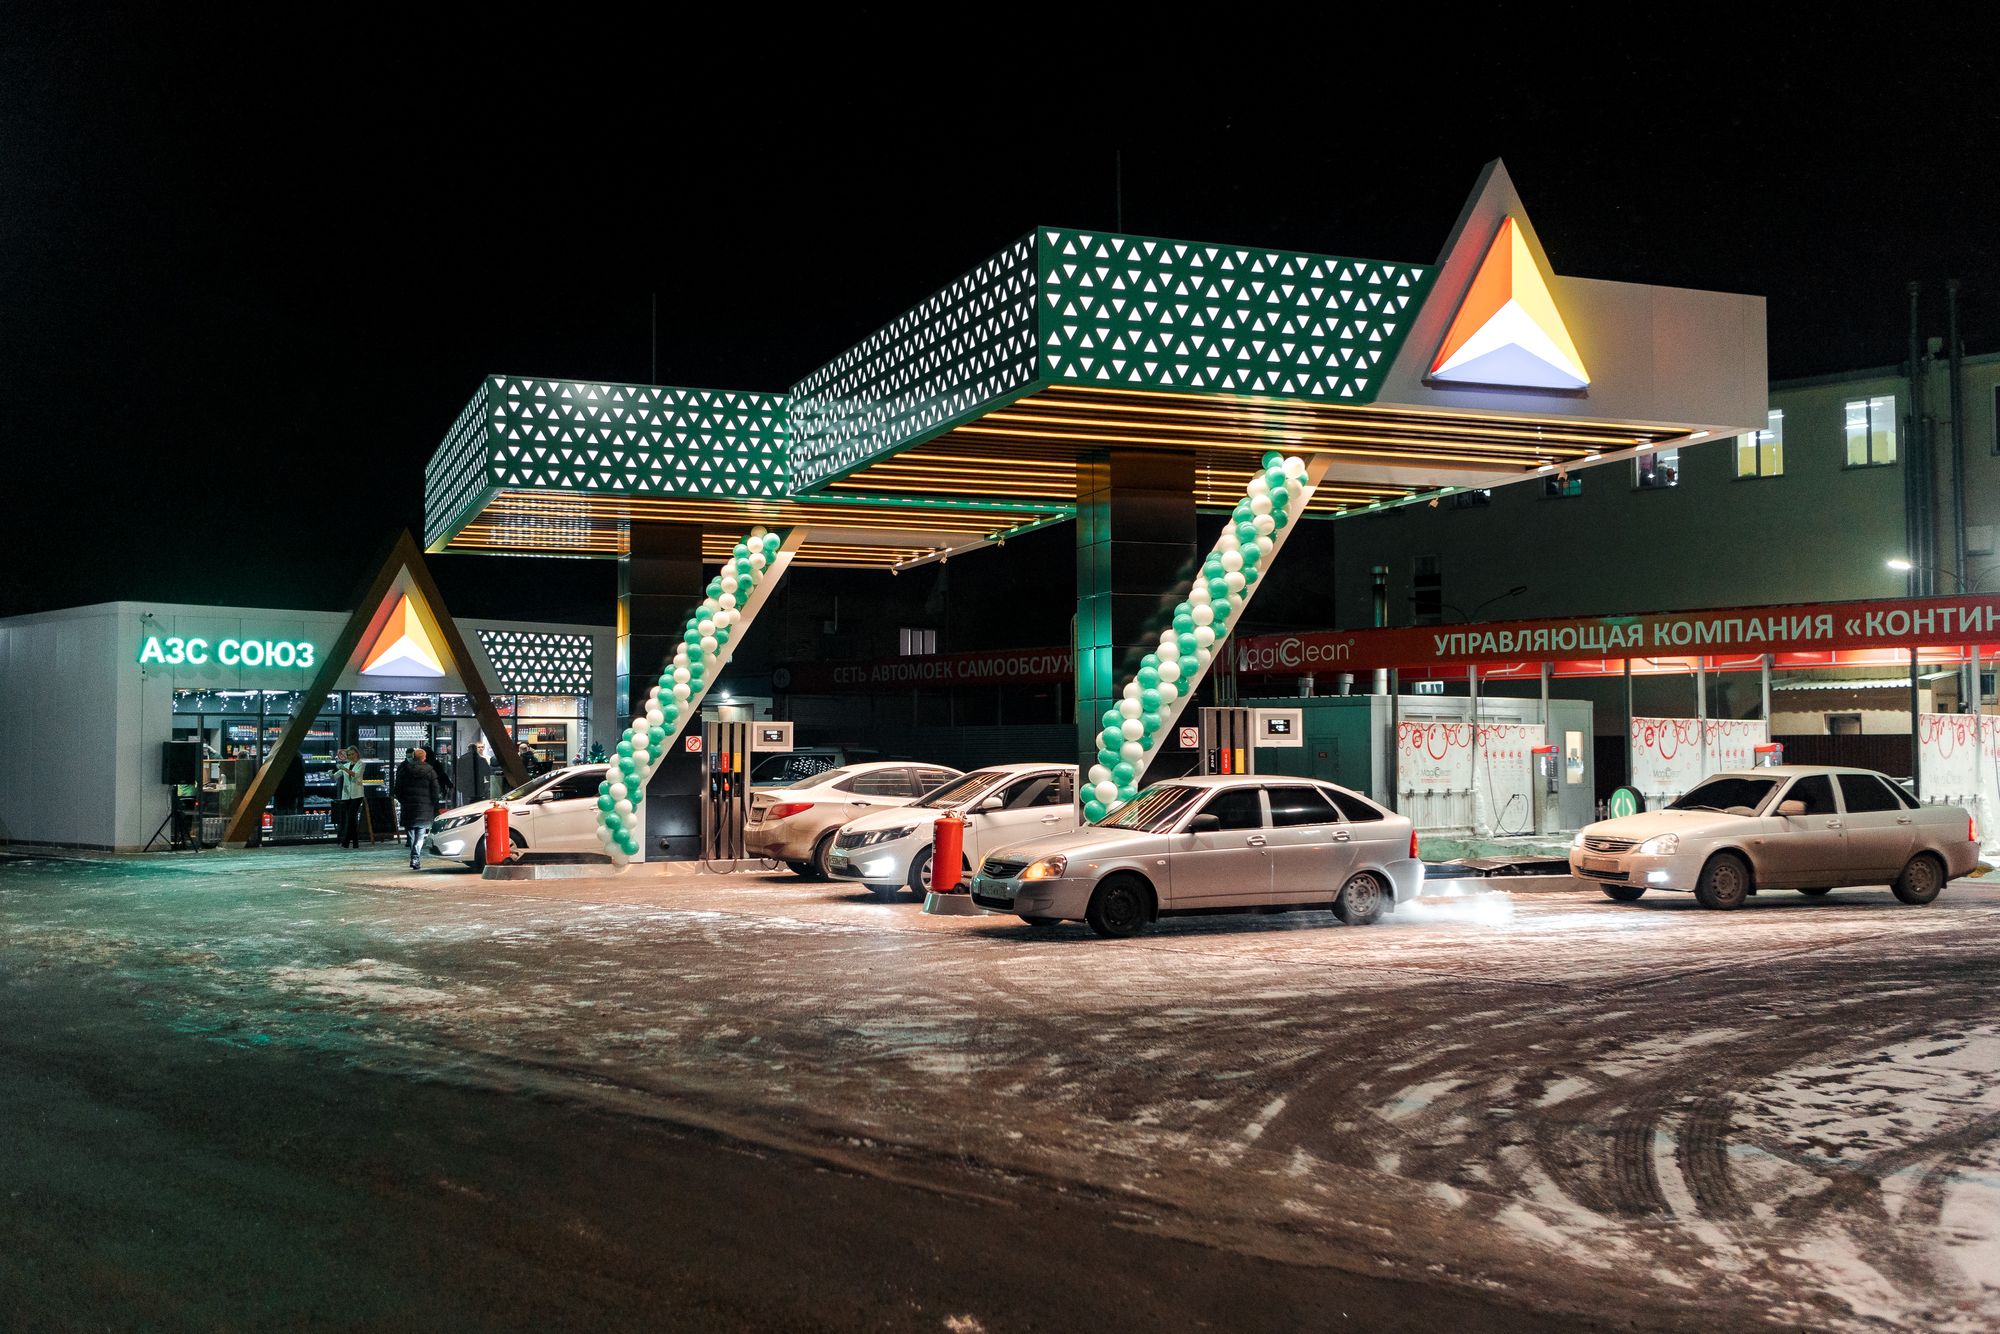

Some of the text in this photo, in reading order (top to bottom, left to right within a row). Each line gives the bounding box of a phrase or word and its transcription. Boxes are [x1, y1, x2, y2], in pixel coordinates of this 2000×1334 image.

[1434, 624, 1643, 656] УПРАВЛЯЮЩАЯ
[1653, 614, 1833, 646] КОМПАНИЯ
[139, 636, 315, 668] АЗС СОЮЗ
[832, 667, 867, 684] СЕТЬ
[871, 660, 954, 683] АВТОМОЕК
